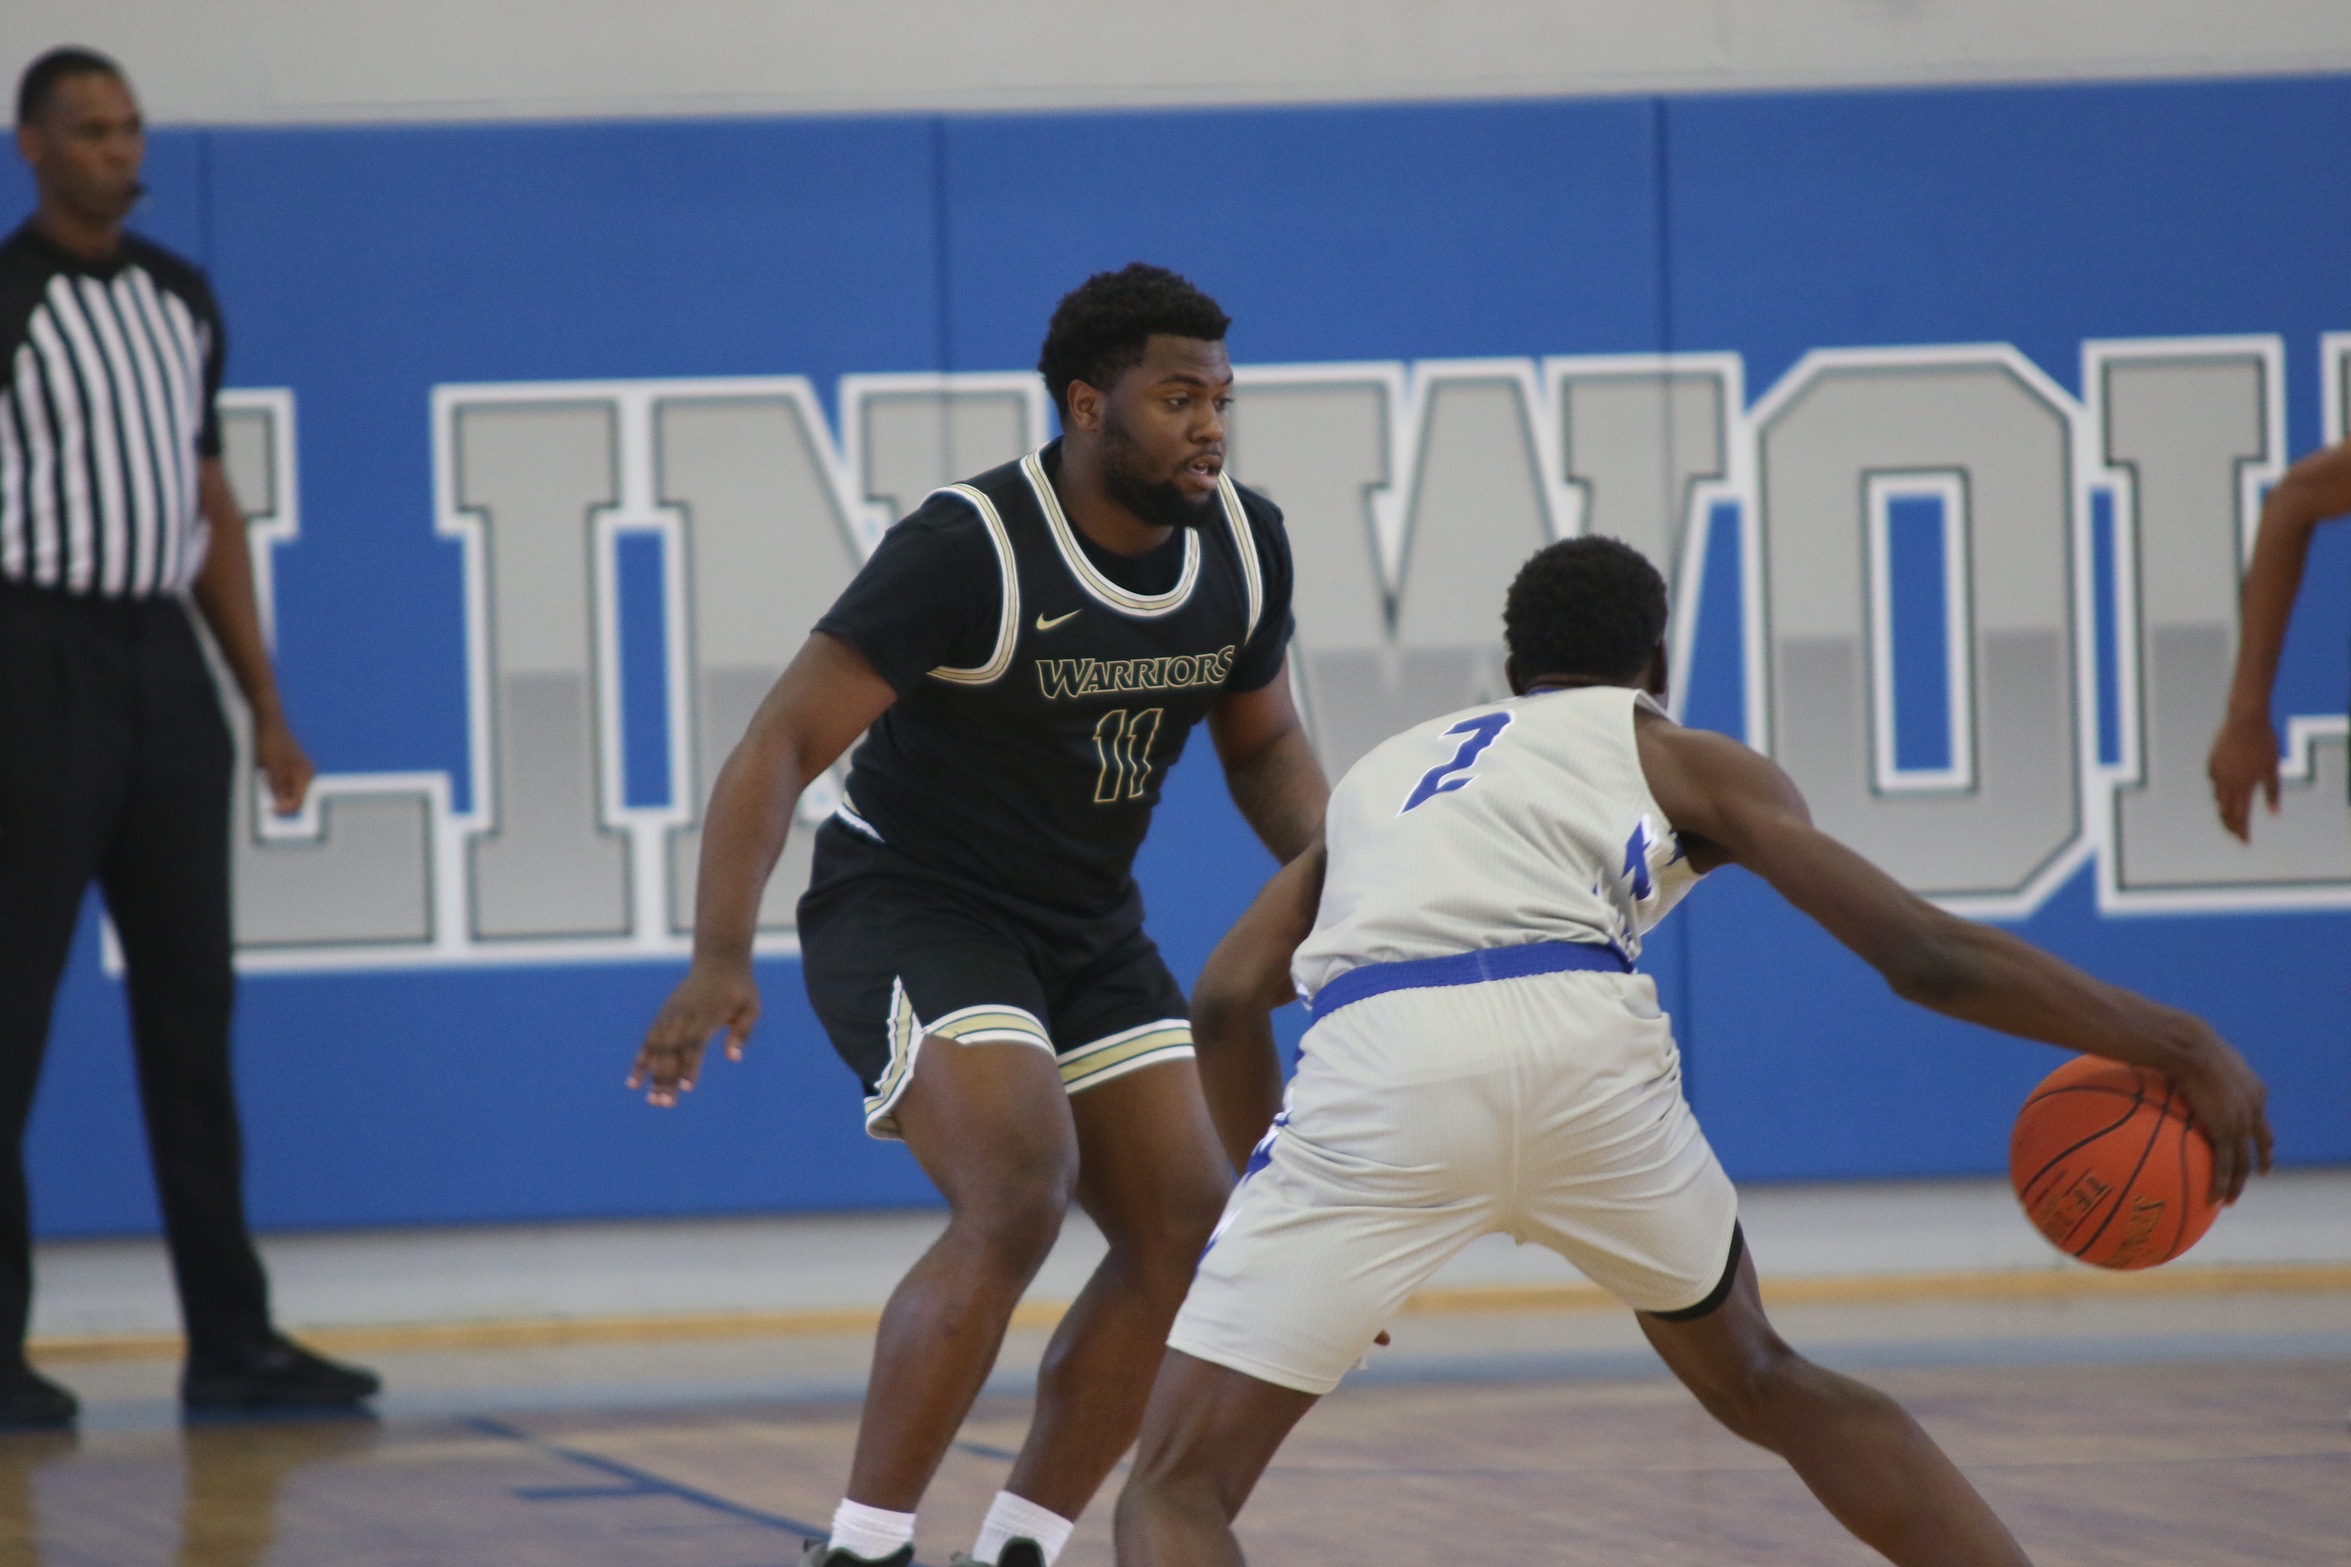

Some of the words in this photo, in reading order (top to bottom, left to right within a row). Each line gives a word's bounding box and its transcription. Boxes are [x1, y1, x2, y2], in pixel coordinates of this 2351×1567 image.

[1035, 645, 1236, 699] WARRIORS
[1092, 707, 1164, 803] 11
[1396, 710, 1516, 817] 2
